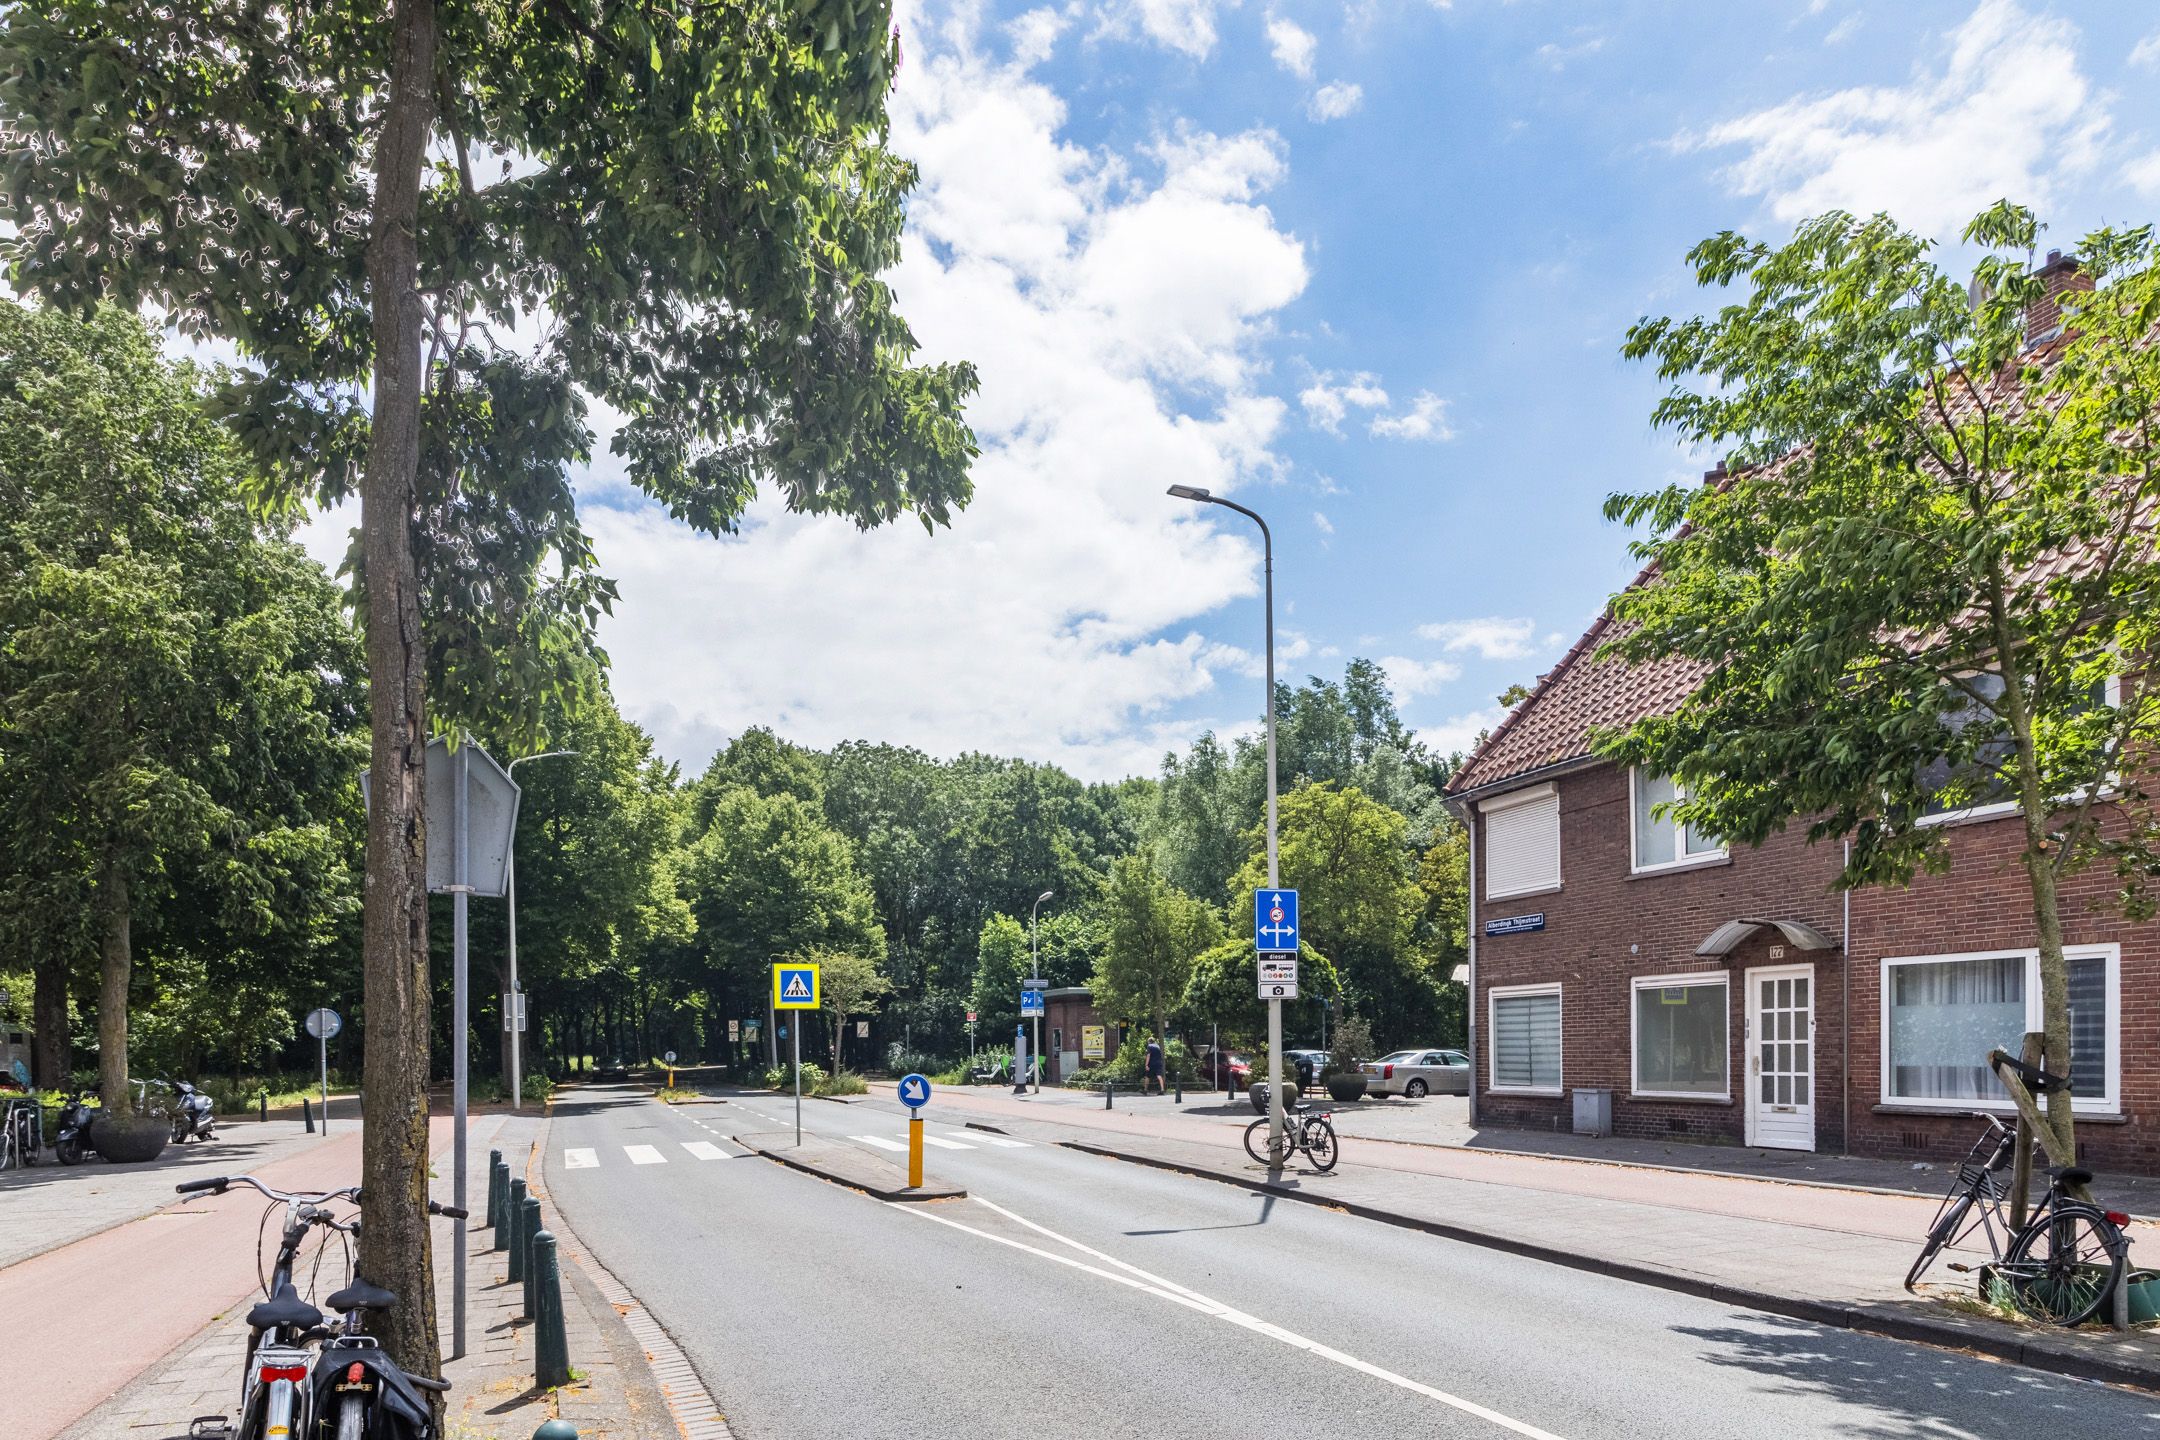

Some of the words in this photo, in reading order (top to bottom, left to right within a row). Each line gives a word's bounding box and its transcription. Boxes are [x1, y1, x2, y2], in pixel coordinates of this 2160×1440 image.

[1487, 920, 1512, 928] Alberdingk
[1513, 916, 1541, 925] Thijmstraat
[1771, 946, 1783, 957] 177
